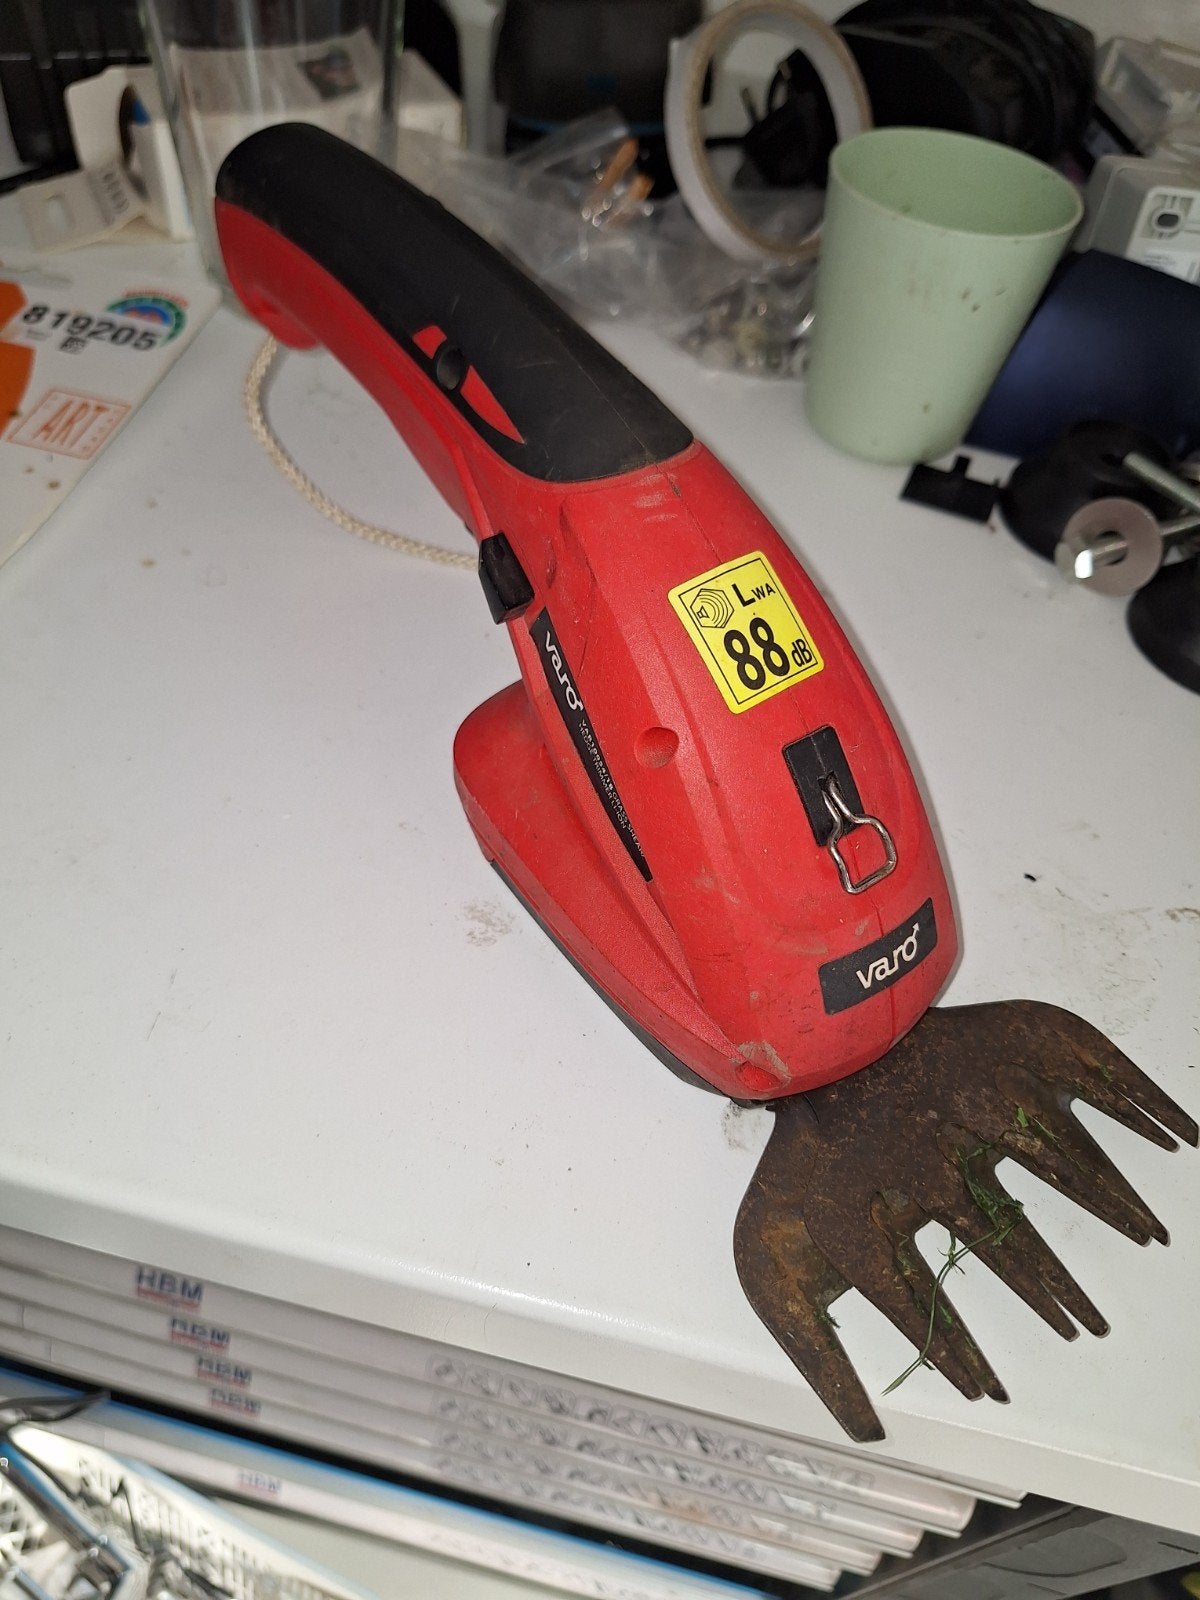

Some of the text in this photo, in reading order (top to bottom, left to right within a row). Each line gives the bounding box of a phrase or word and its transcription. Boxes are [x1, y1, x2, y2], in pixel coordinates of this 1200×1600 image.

[23, 305, 159, 351] 819205
[32, 400, 111, 448] ART
[731, 583, 776, 608] LWA
[545, 631, 584, 711] varo
[723, 617, 813, 691] 88 dB
[592, 757, 613, 800] TRIMMER
[612, 792, 628, 823] GRASS
[855, 922, 919, 989] varo
[135, 1266, 203, 1302] HBM
